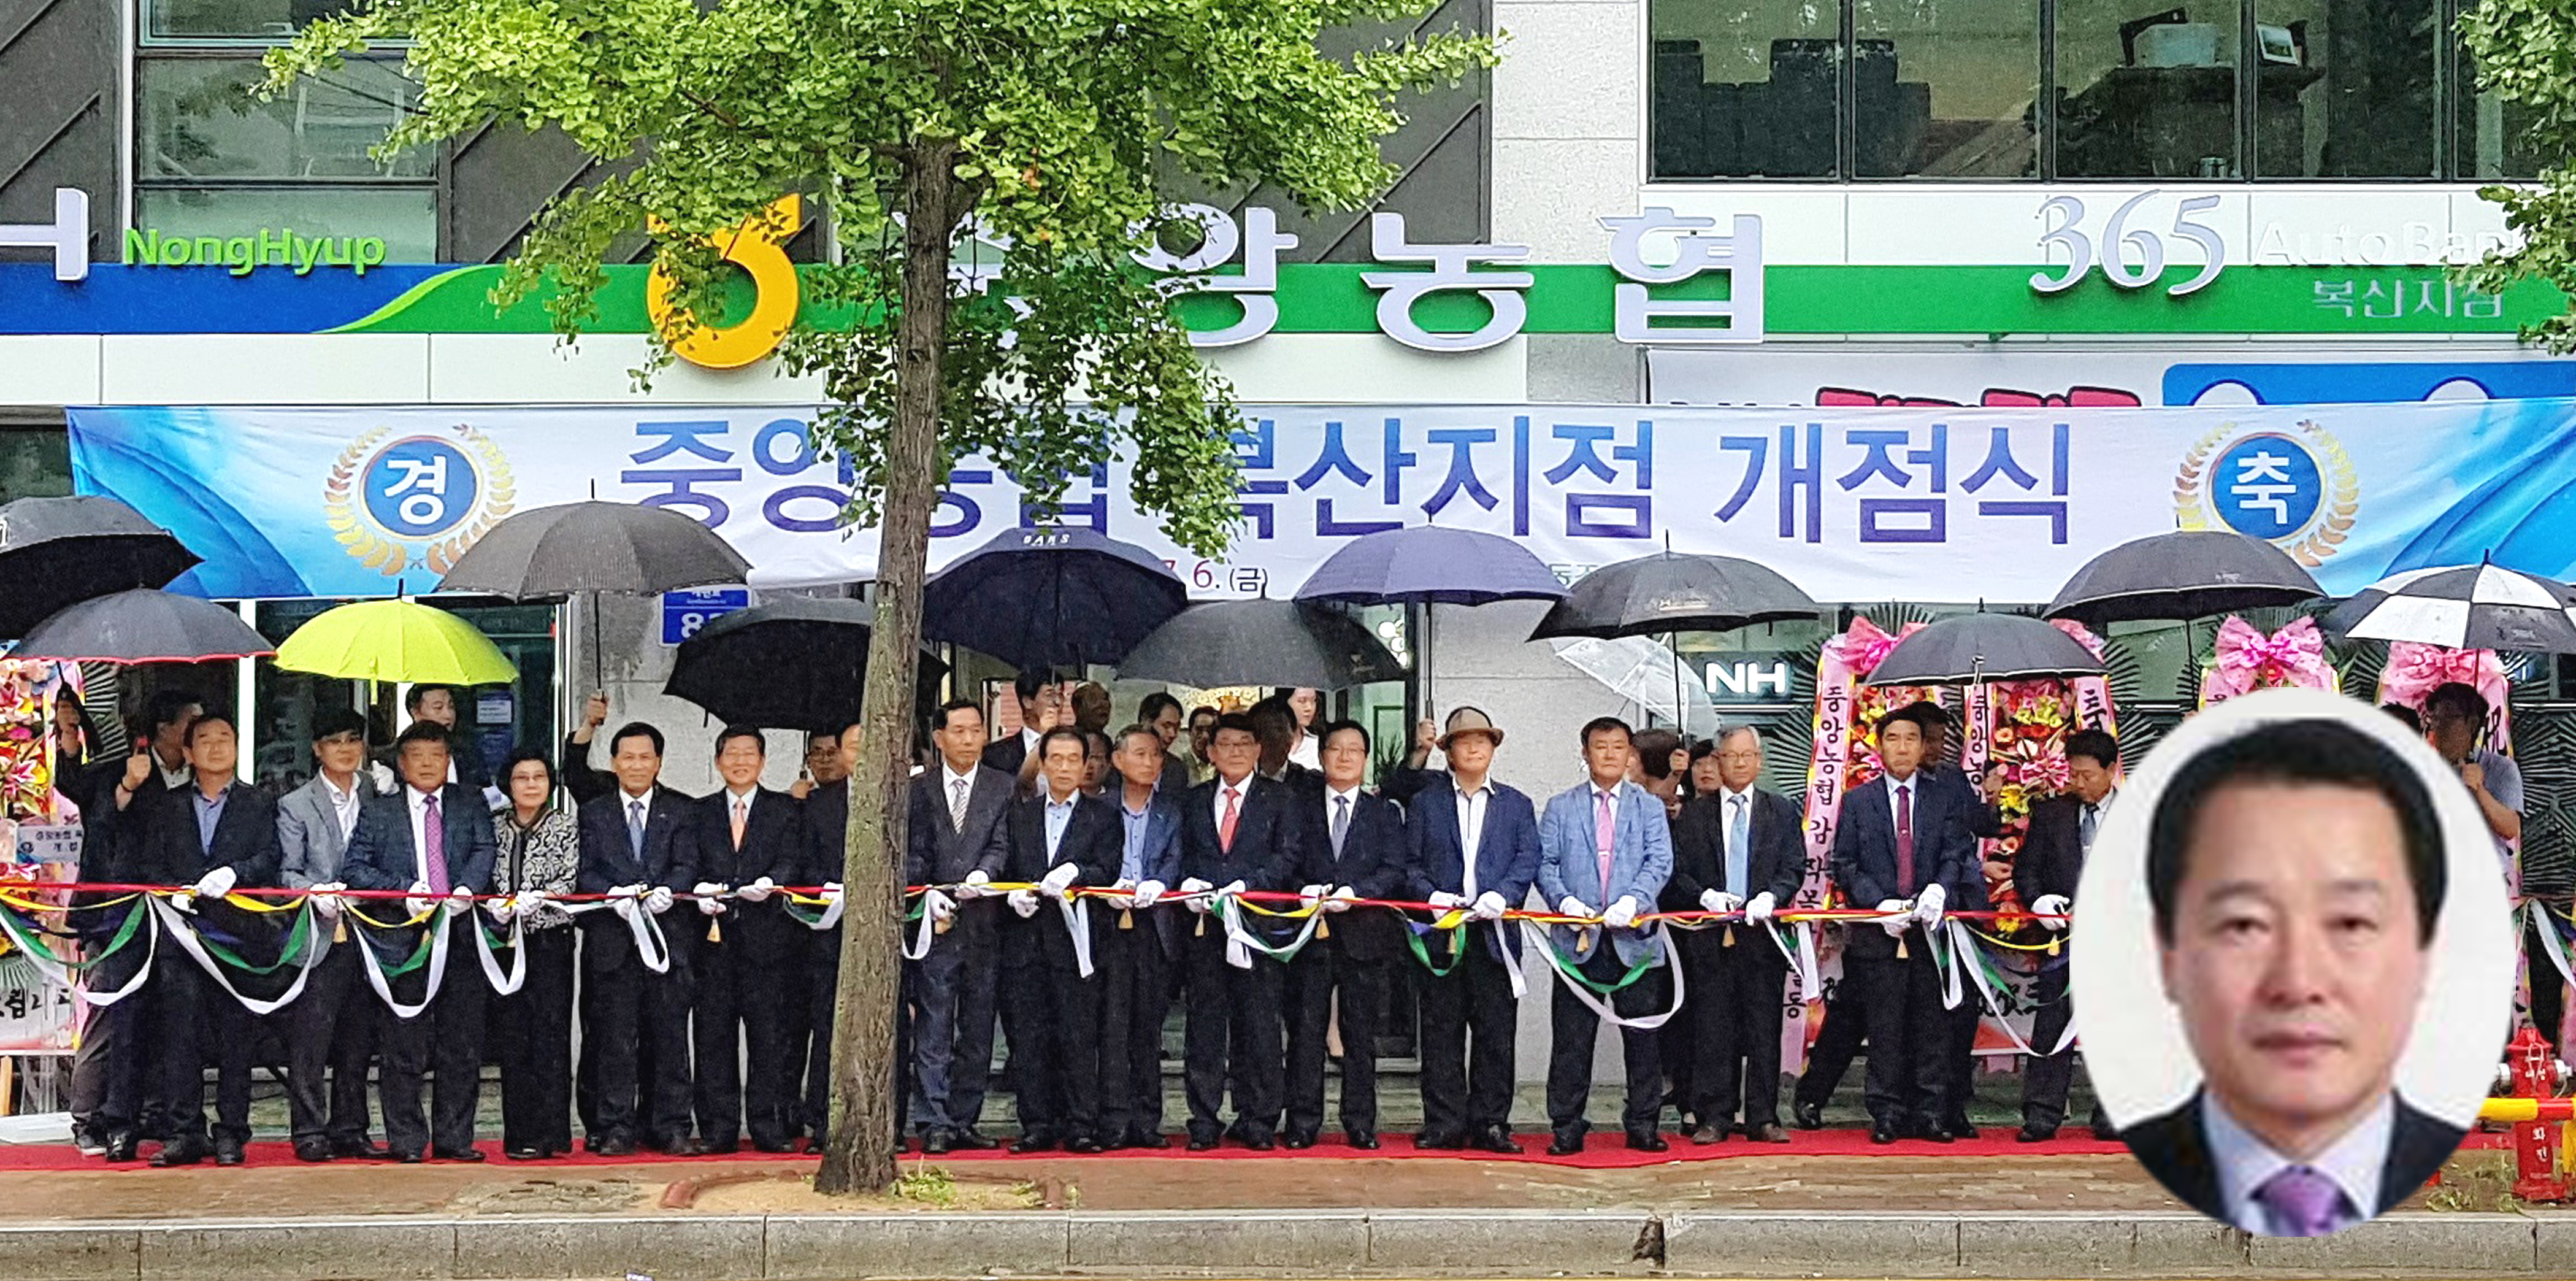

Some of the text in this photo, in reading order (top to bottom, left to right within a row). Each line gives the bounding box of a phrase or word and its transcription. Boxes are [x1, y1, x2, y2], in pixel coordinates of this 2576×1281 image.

[124, 228, 386, 277] NongHyup
[2029, 188, 2225, 295] 365
[384, 455, 447, 526] 경
[1713, 422, 2070, 545] 개점식
[2230, 452, 2297, 524] 축
[1229, 567, 1268, 593] (금)
[1706, 662, 1786, 693] NH
[1814, 686, 1847, 806] 중앙농협
[1960, 694, 1989, 805] 중앙농
